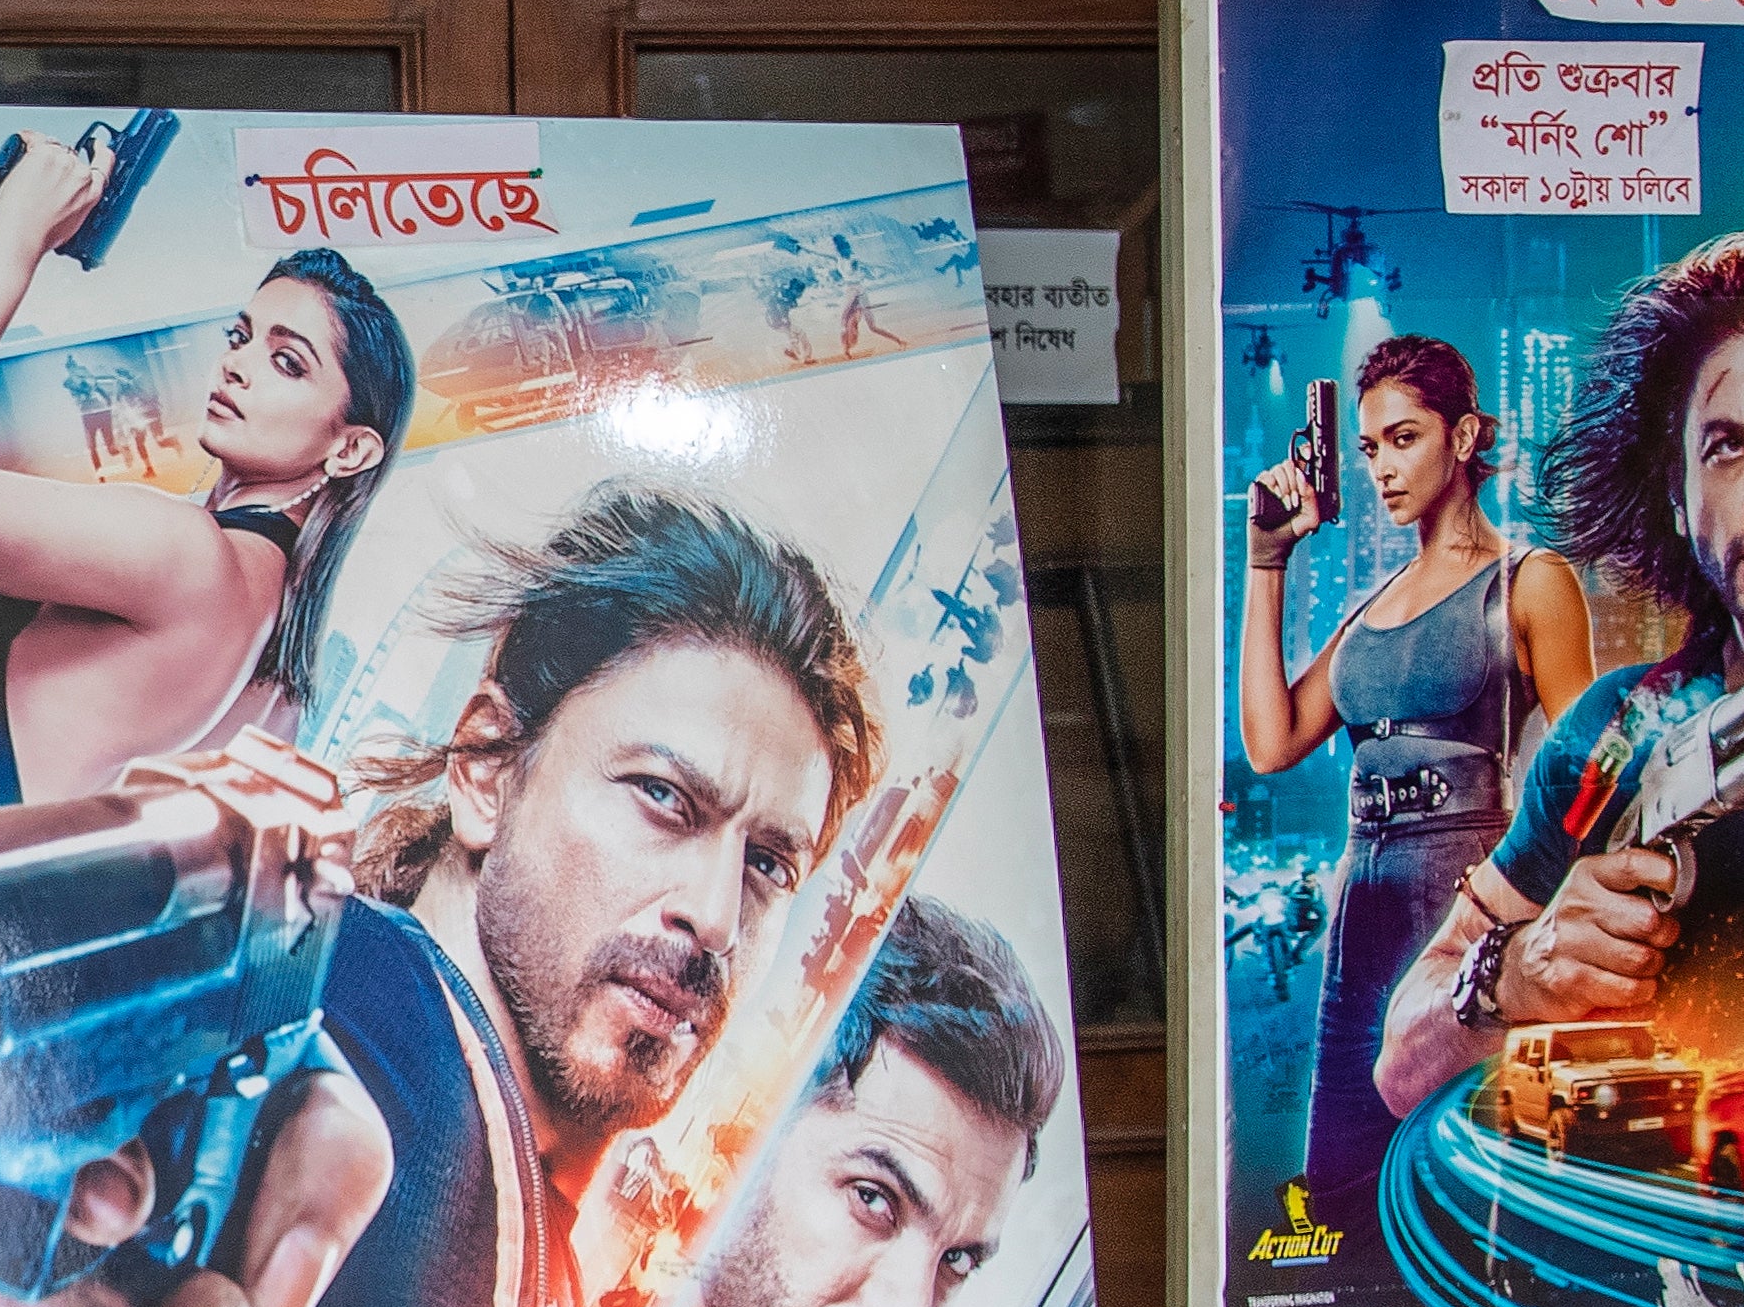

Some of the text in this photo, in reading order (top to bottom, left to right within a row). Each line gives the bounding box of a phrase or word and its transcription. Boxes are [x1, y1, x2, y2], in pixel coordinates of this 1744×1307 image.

[1473, 49, 1682, 99] প্রতি শুক্রবার
[259, 148, 560, 240] চলিতেছে
[1458, 173, 1531, 204] সকাল
[1619, 166, 1693, 204] চলিবে
[984, 275, 1111, 310] বহার ব্যতীত
[1014, 319, 1076, 352] নিষেধ
[1247, 1224, 1345, 1261] ACTION CUT
